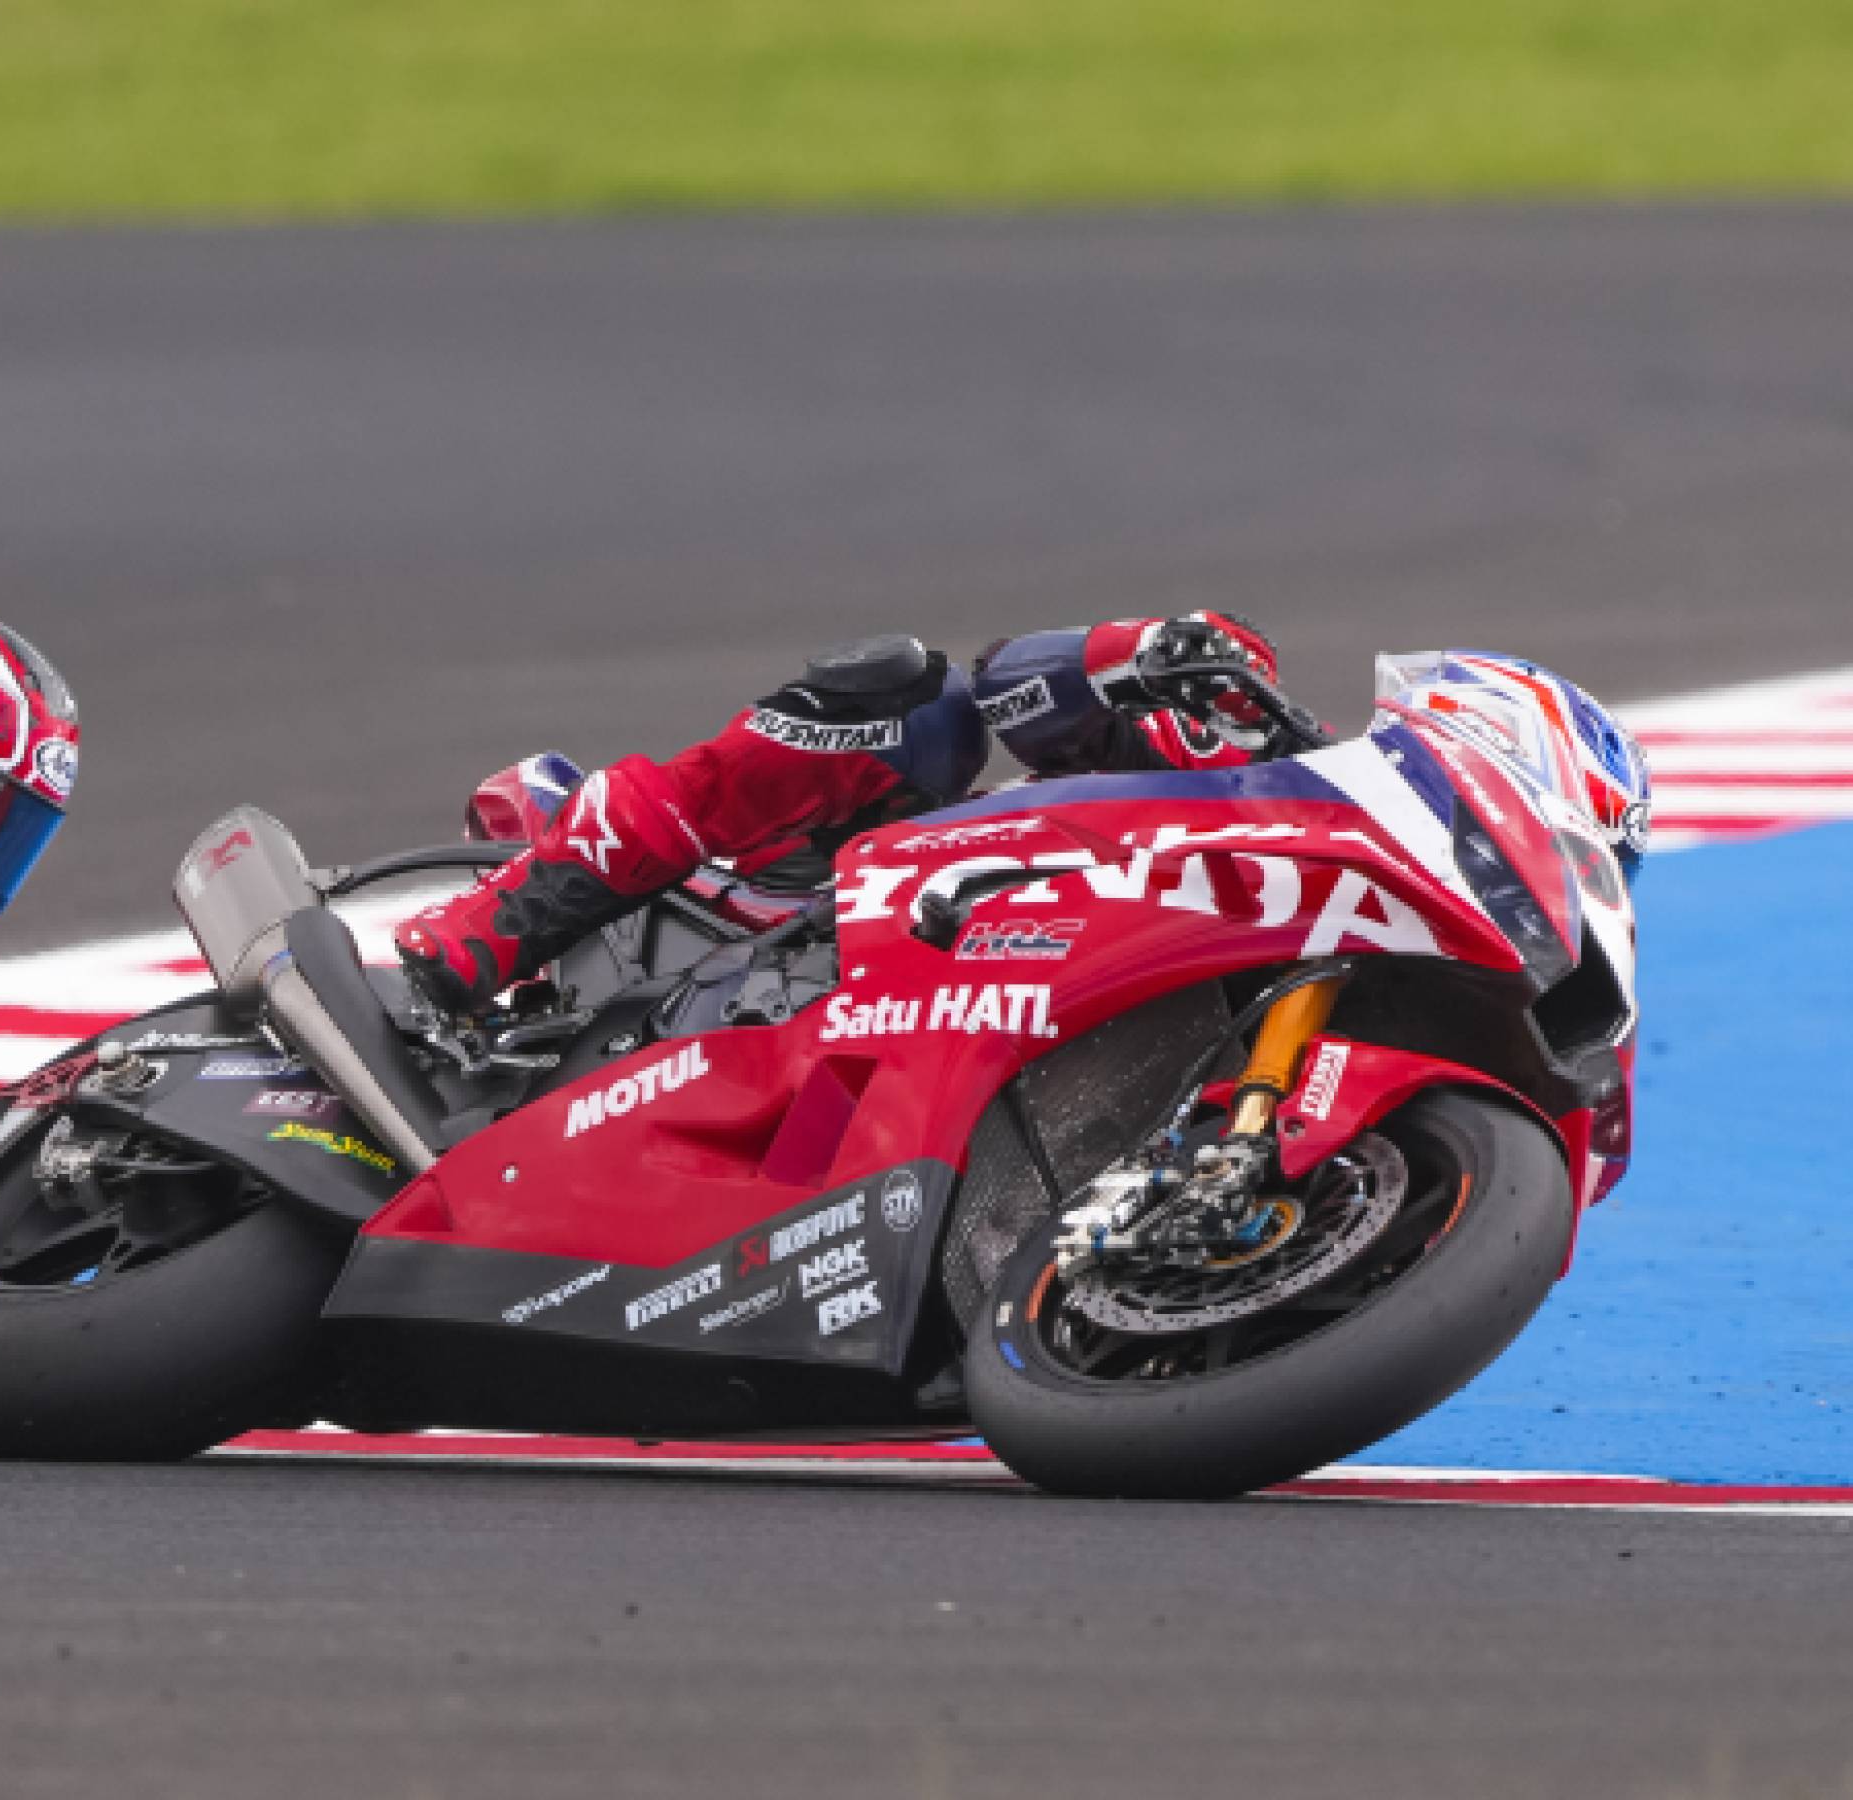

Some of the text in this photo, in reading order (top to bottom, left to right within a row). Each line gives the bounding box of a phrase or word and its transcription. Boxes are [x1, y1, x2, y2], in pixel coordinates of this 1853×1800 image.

[820, 984, 1059, 1042] Satu HATI.
[564, 1042, 709, 1138] MOTUL
[799, 1239, 867, 1288] NGK
[818, 1280, 883, 1335] RK
